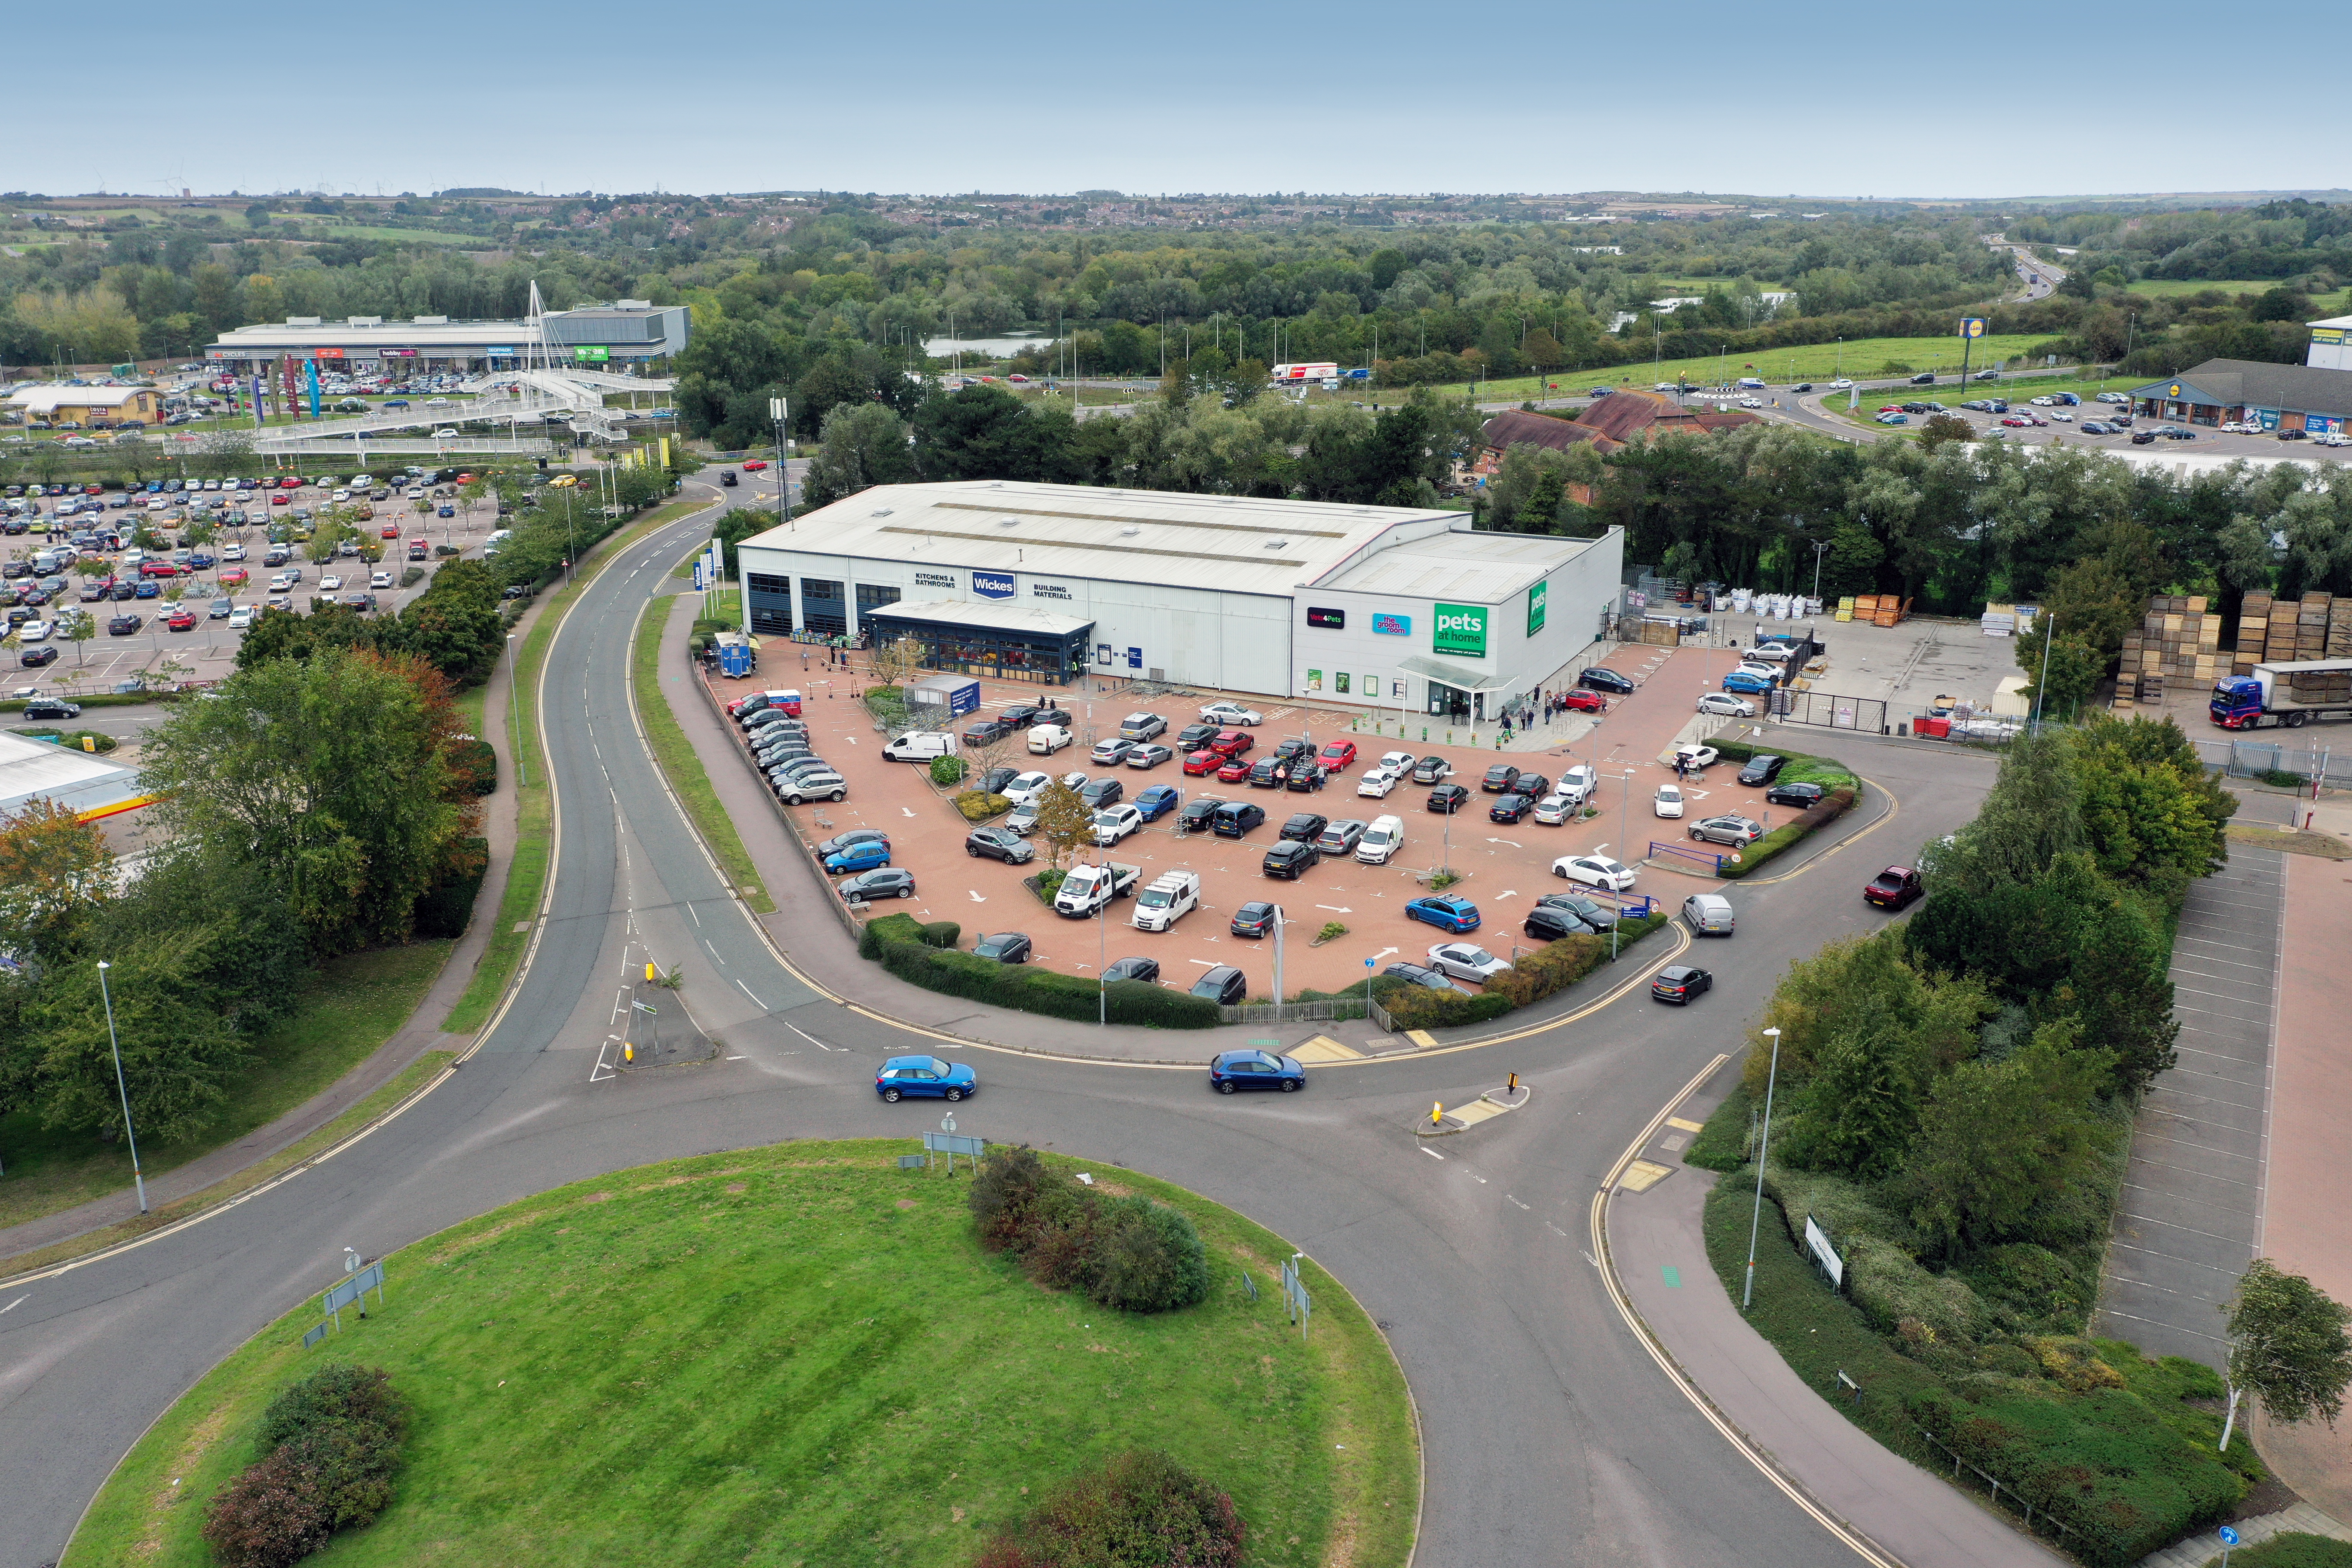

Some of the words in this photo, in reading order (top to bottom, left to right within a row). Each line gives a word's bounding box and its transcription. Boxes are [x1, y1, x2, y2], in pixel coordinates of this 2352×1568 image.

[916, 573, 948, 581] KITCHENS
[916, 579, 956, 588] BATHROOMS
[974, 578, 1013, 592] Wickes
[1034, 584, 1066, 593] BUILDING
[1034, 591, 1072, 600] MATERIALS
[1531, 591, 1545, 615] pets
[1310, 614, 1341, 623] Vets4Pets
[1438, 613, 1482, 631] pets
[1438, 631, 1449, 640] at
[1451, 631, 1480, 643] home
